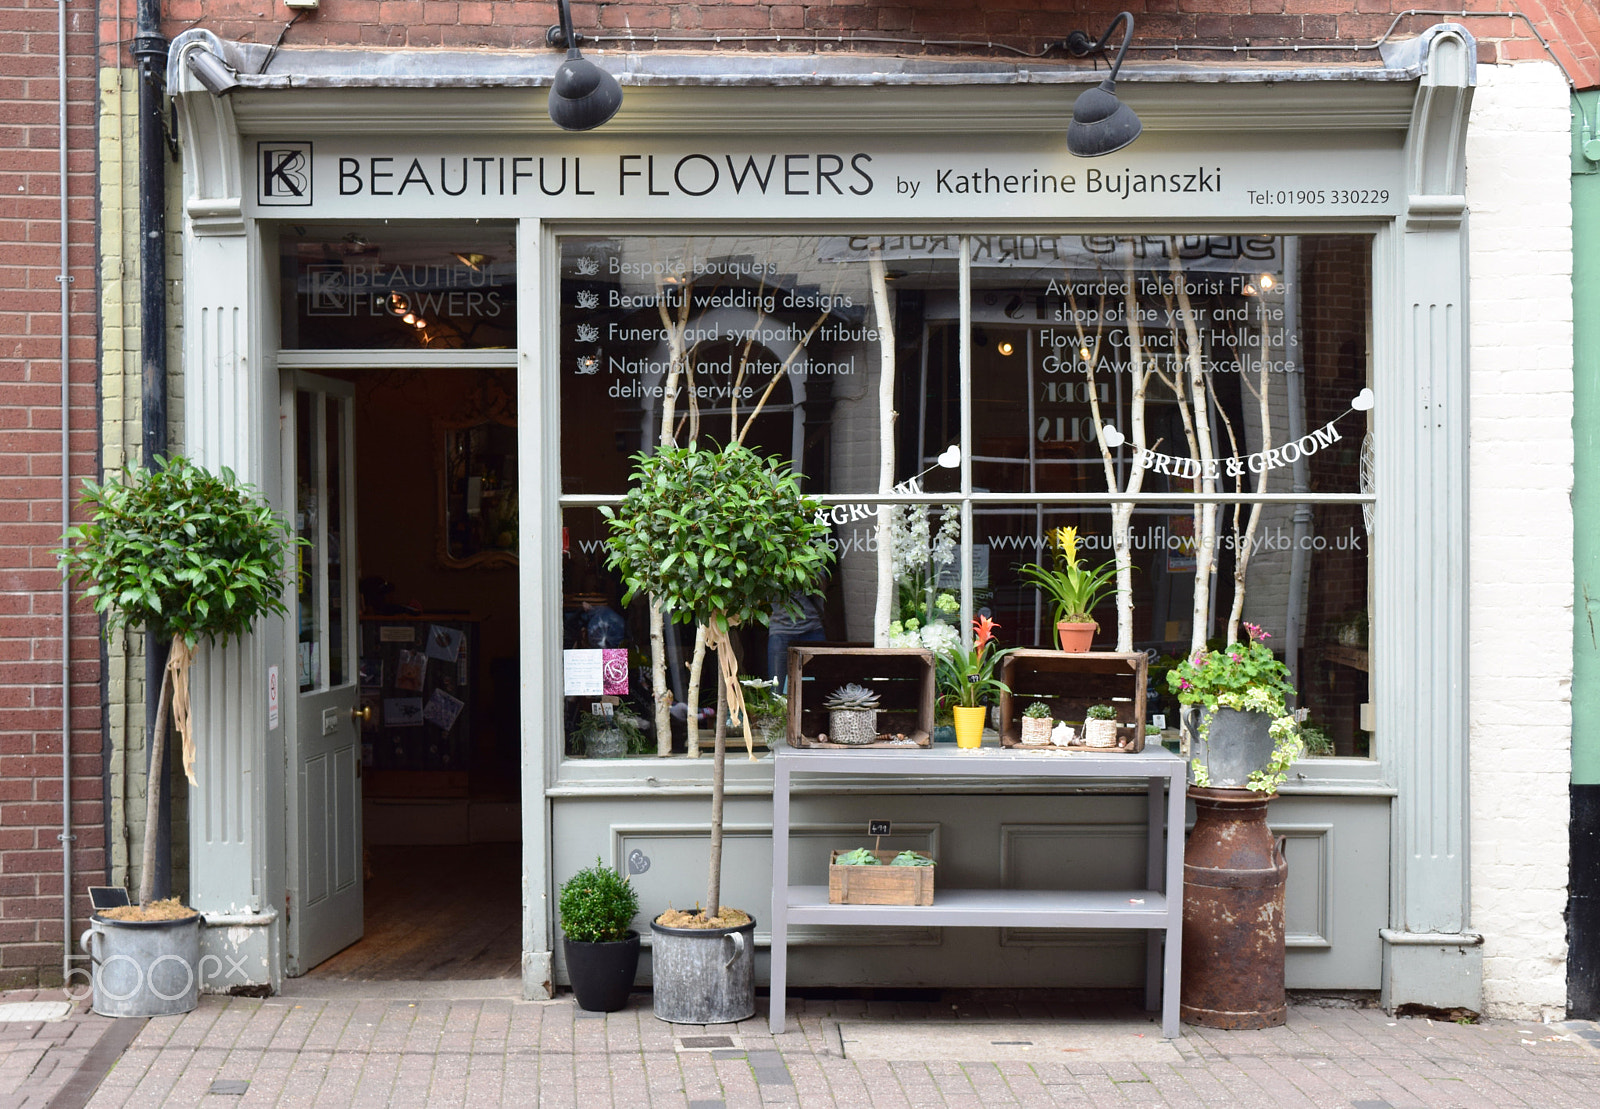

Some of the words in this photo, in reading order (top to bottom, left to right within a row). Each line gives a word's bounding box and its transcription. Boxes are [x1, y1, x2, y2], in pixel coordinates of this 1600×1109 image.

[339, 157, 595, 196] BEAUTIFUL
[619, 153, 874, 196] FLOWERS
[896, 176, 921, 198] by
[936, 169, 1076, 195] Katherine
[1086, 167, 1222, 200] Bujanszki
[1330, 189, 1390, 205] 330229
[353, 264, 502, 287] BEAUTIFUL
[609, 256, 686, 280] Bespoke
[693, 255, 776, 280] bouquets
[1045, 276, 1131, 295] Awarded
[1138, 276, 1224, 295] Teleflorist
[1230, 275, 1293, 295] Flower
[353, 291, 501, 317] FLOWERS
[609, 288, 687, 308] Beautiful
[694, 288, 775, 313] wedding
[782, 288, 853, 314] designs
[1054, 302, 1099, 327] shop
[1105, 302, 1124, 321] of
[1130, 302, 1158, 321] the
[1164, 308, 1207, 327] year
[1212, 301, 1249, 321] and
[1256, 301, 1284, 321] the
[609, 321, 676, 341] Funeral
[683, 321, 719, 341] and
[726, 321, 814, 346] sympathy
[820, 321, 886, 342] tributes
[1040, 328, 1102, 347] Flower
[1108, 328, 1179, 347] Council
[609, 355, 689, 374] National
[696, 355, 732, 374] and
[740, 355, 854, 375] international
[1042, 354, 1090, 374] Gold
[1165, 353, 1192, 373] for
[1199, 353, 1295, 373] Excellence
[608, 378, 683, 402] delivery
[689, 381, 753, 398] service
[1138, 450, 1219, 480] BRIDE
[1226, 456, 1246, 478] &
[1247, 422, 1342, 473] GROOM
